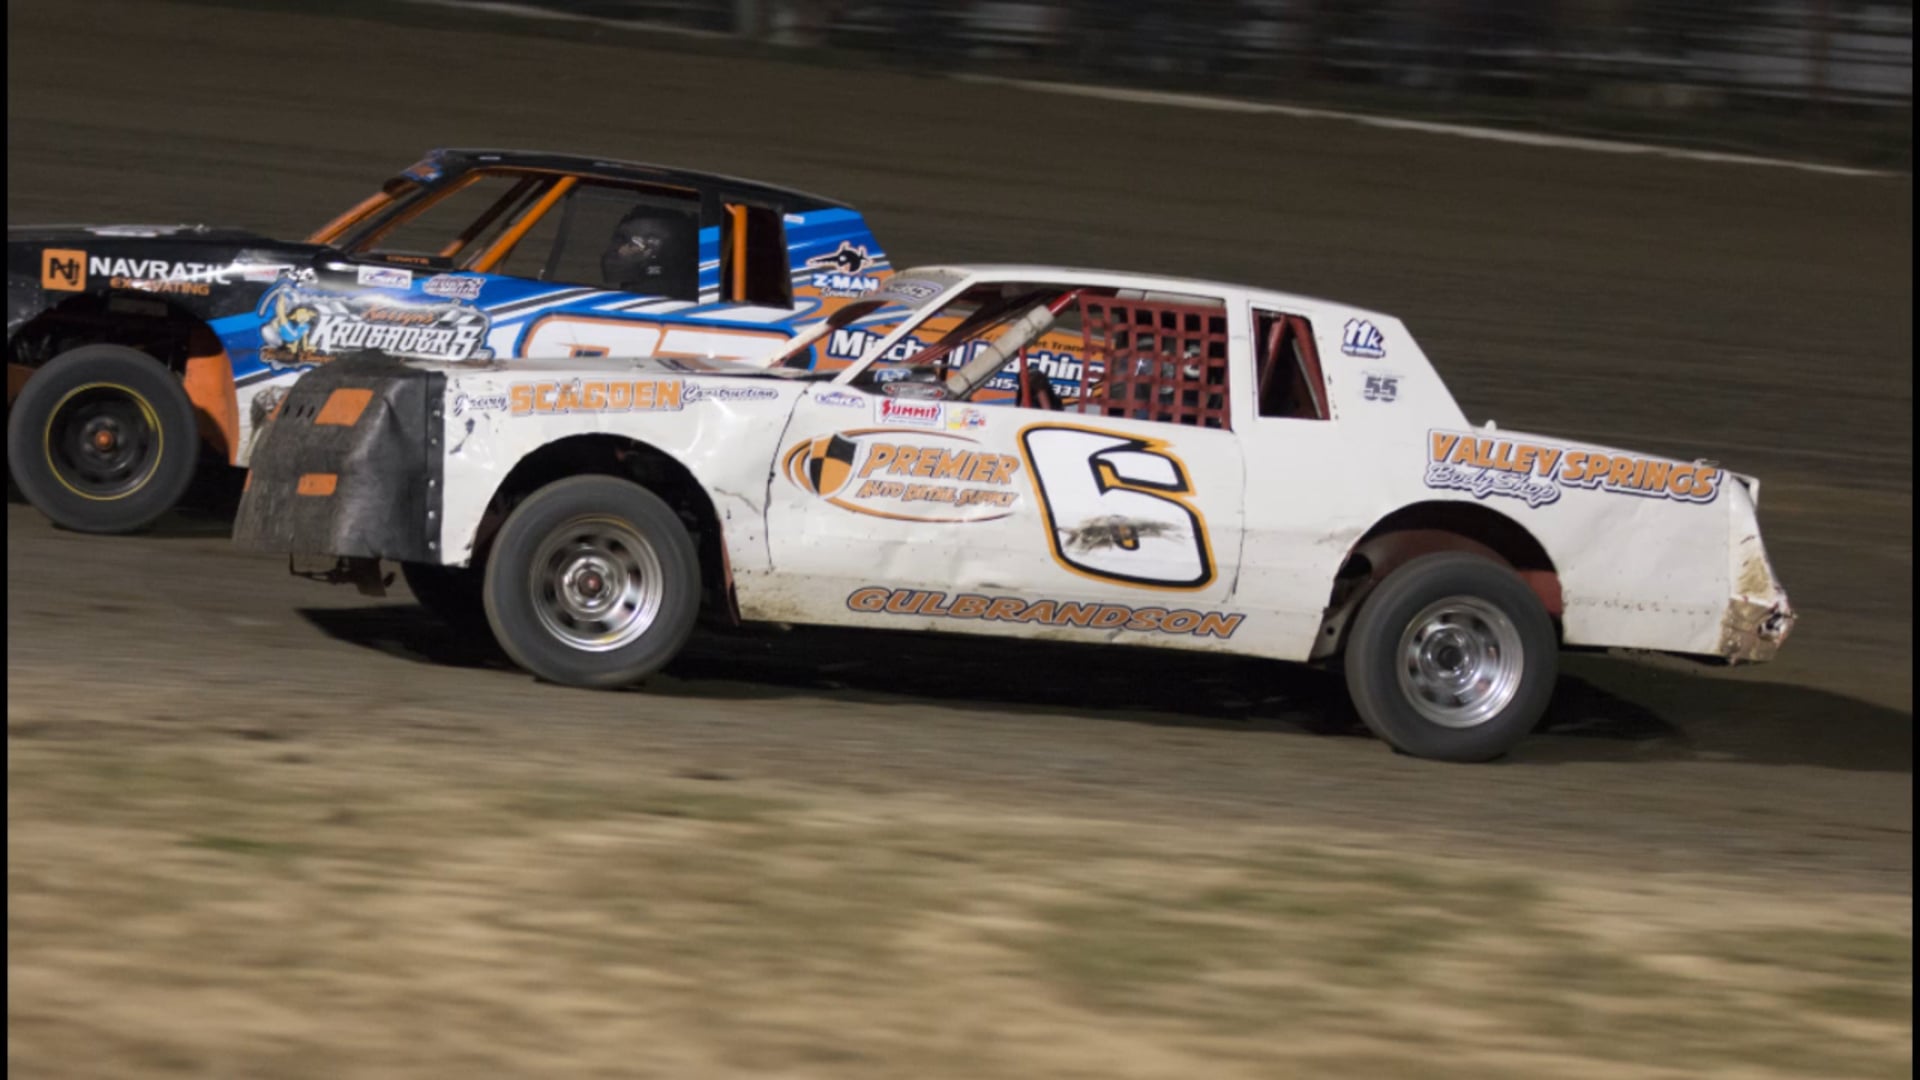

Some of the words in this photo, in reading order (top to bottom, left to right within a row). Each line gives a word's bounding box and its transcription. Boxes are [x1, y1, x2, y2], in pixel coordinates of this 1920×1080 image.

[89, 256, 231, 285] NAVRATIL
[110, 276, 210, 296] EXAVATING
[309, 315, 482, 360] KRUSADERS
[830, 329, 966, 368] Michl
[508, 379, 681, 414] SCAGDEN
[682, 382, 779, 404] Construction
[1364, 376, 1398, 402] 55
[882, 398, 942, 420] SUMMIT
[858, 442, 1021, 484] PREMIER
[1431, 431, 1562, 477] VALLEY
[1562, 451, 1724, 498] SPRINGS
[855, 480, 905, 498] AUTO
[954, 487, 1020, 508] SUPPLY
[1018, 421, 1217, 592] 6
[847, 587, 1246, 639] GULBRANDSON
